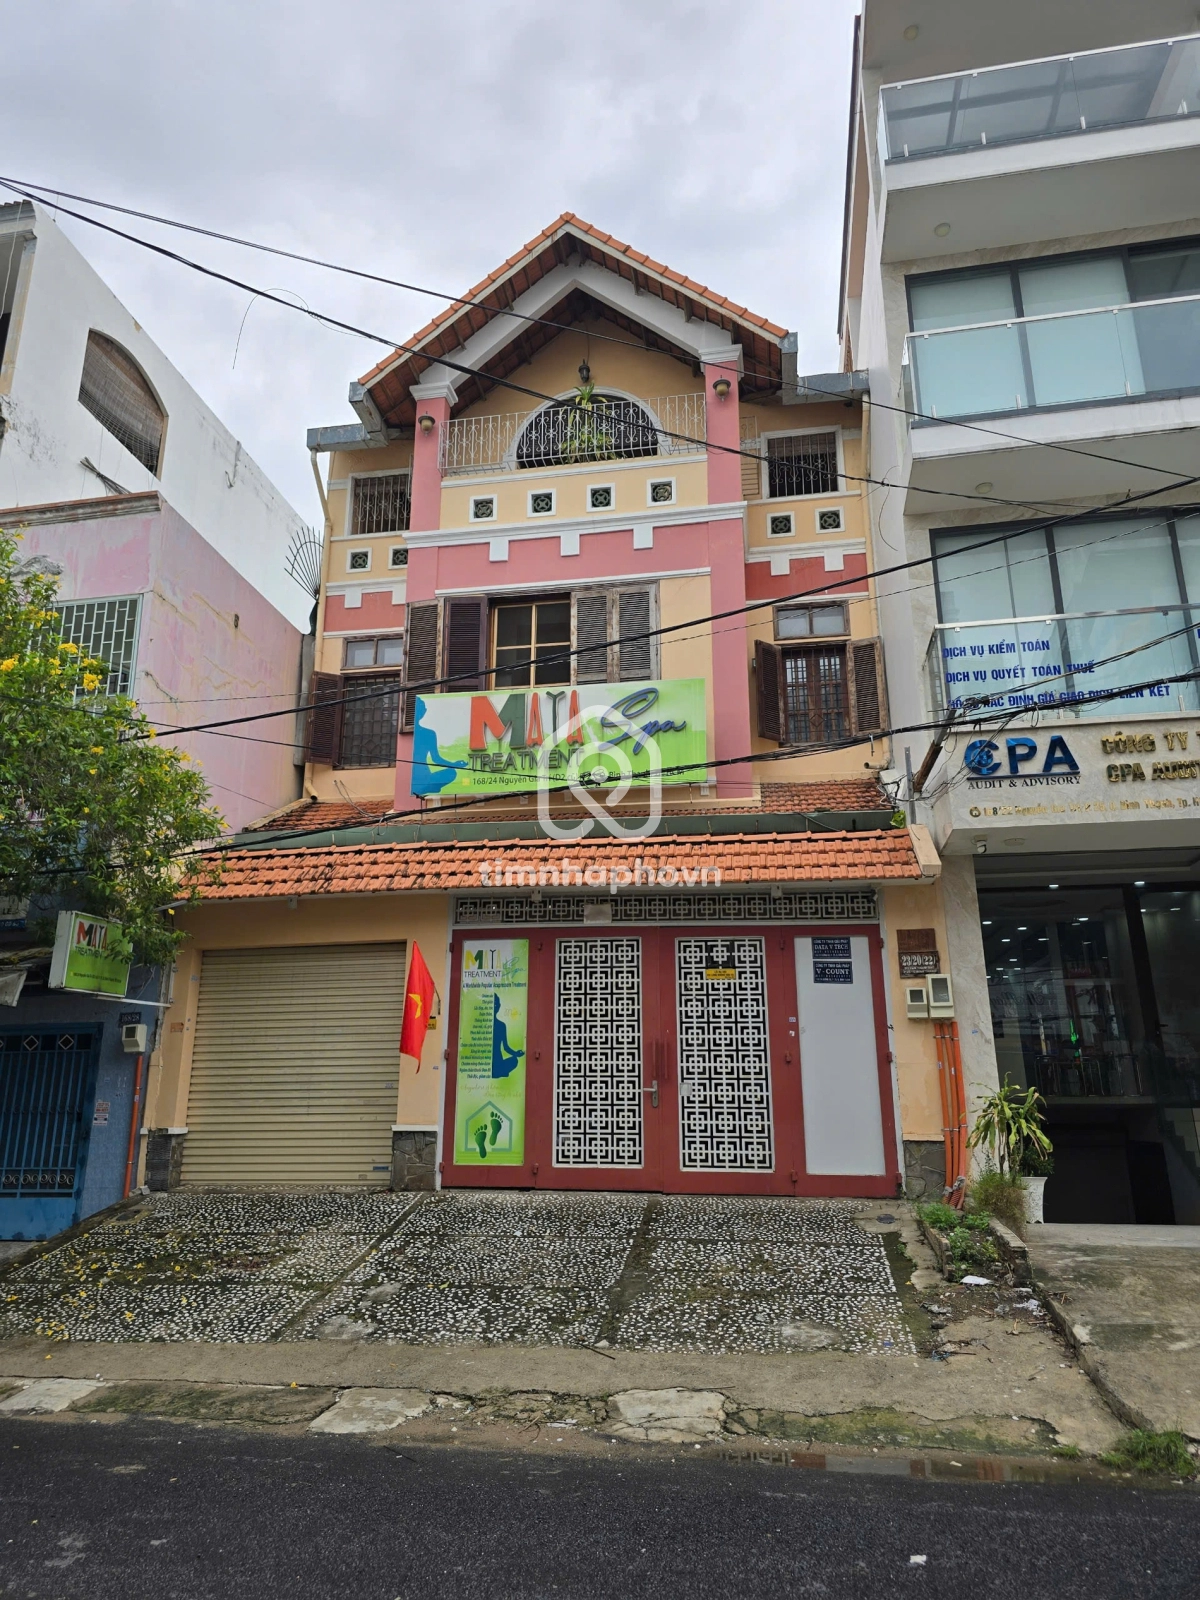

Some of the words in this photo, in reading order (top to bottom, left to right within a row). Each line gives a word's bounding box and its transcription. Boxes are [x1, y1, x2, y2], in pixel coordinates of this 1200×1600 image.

[943, 646, 967, 660] DỊCH
[970, 644, 985, 658] VỤ
[988, 639, 1016, 654] KIỂM
[1020, 639, 1051, 653] TOÁN
[946, 669, 970, 684] DỊCH
[973, 669, 988, 683] VỤ
[991, 664, 1026, 681] QUYẾT
[1031, 662, 1062, 677] TOÁN
[469, 689, 584, 750] MAYA
[598, 687, 687, 755] Spa
[1101, 731, 1157, 755] CÔNG
[1163, 731, 1189, 751] TY
[468, 749, 584, 772] TREATMENT
[964, 735, 1080, 775] CPA
[473, 776, 497, 786] 168/24
[968, 779, 1004, 790] AUDIT
[1008, 778, 1018, 788] &
[1021, 775, 1082, 788] ADVISORY
[1106, 762, 1147, 782] CPA
[464, 949, 502, 970] MAYA
[464, 970, 502, 978] TREATMENT
